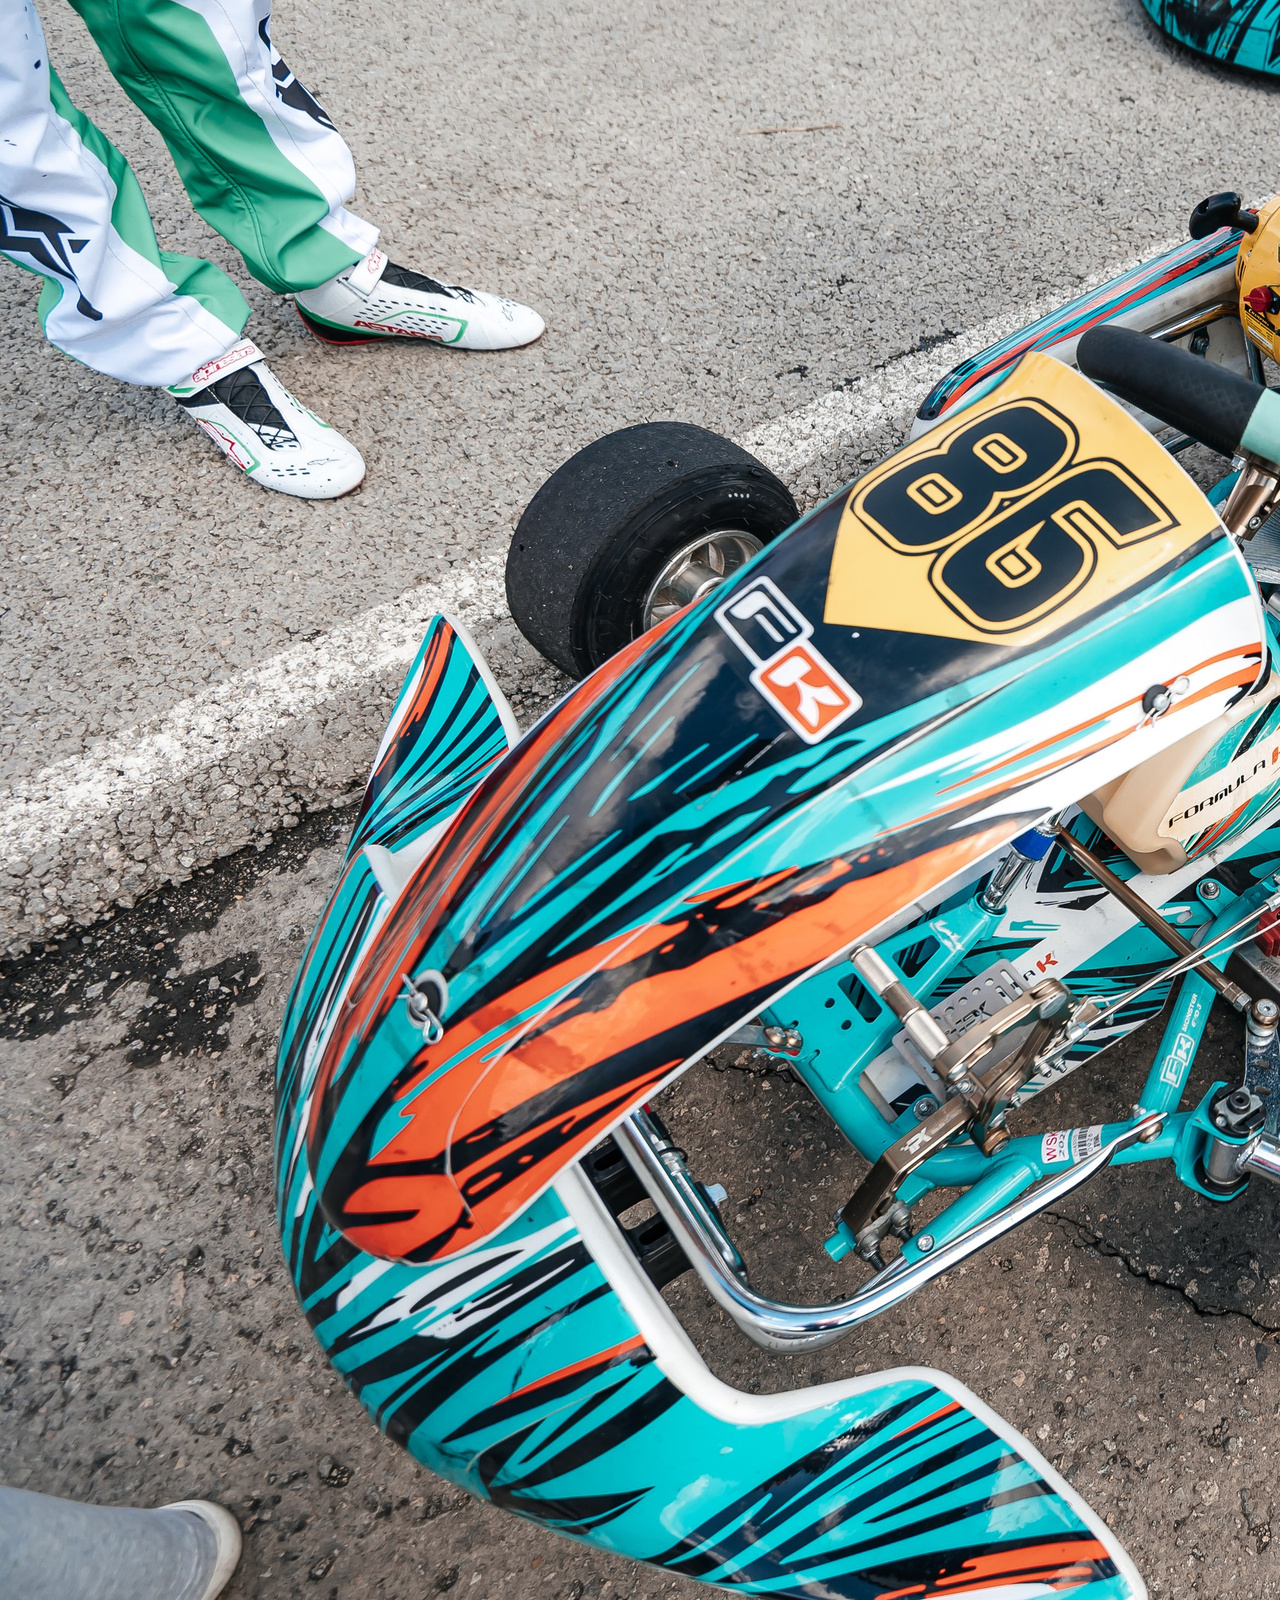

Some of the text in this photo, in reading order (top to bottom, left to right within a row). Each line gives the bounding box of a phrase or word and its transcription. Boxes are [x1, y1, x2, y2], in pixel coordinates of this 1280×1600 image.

[192, 345, 256, 383] alpinestars
[850, 396, 1181, 635] 86
[1168, 759, 1266, 829] FORMULA
[1181, 992, 1198, 1033] MONSTER
